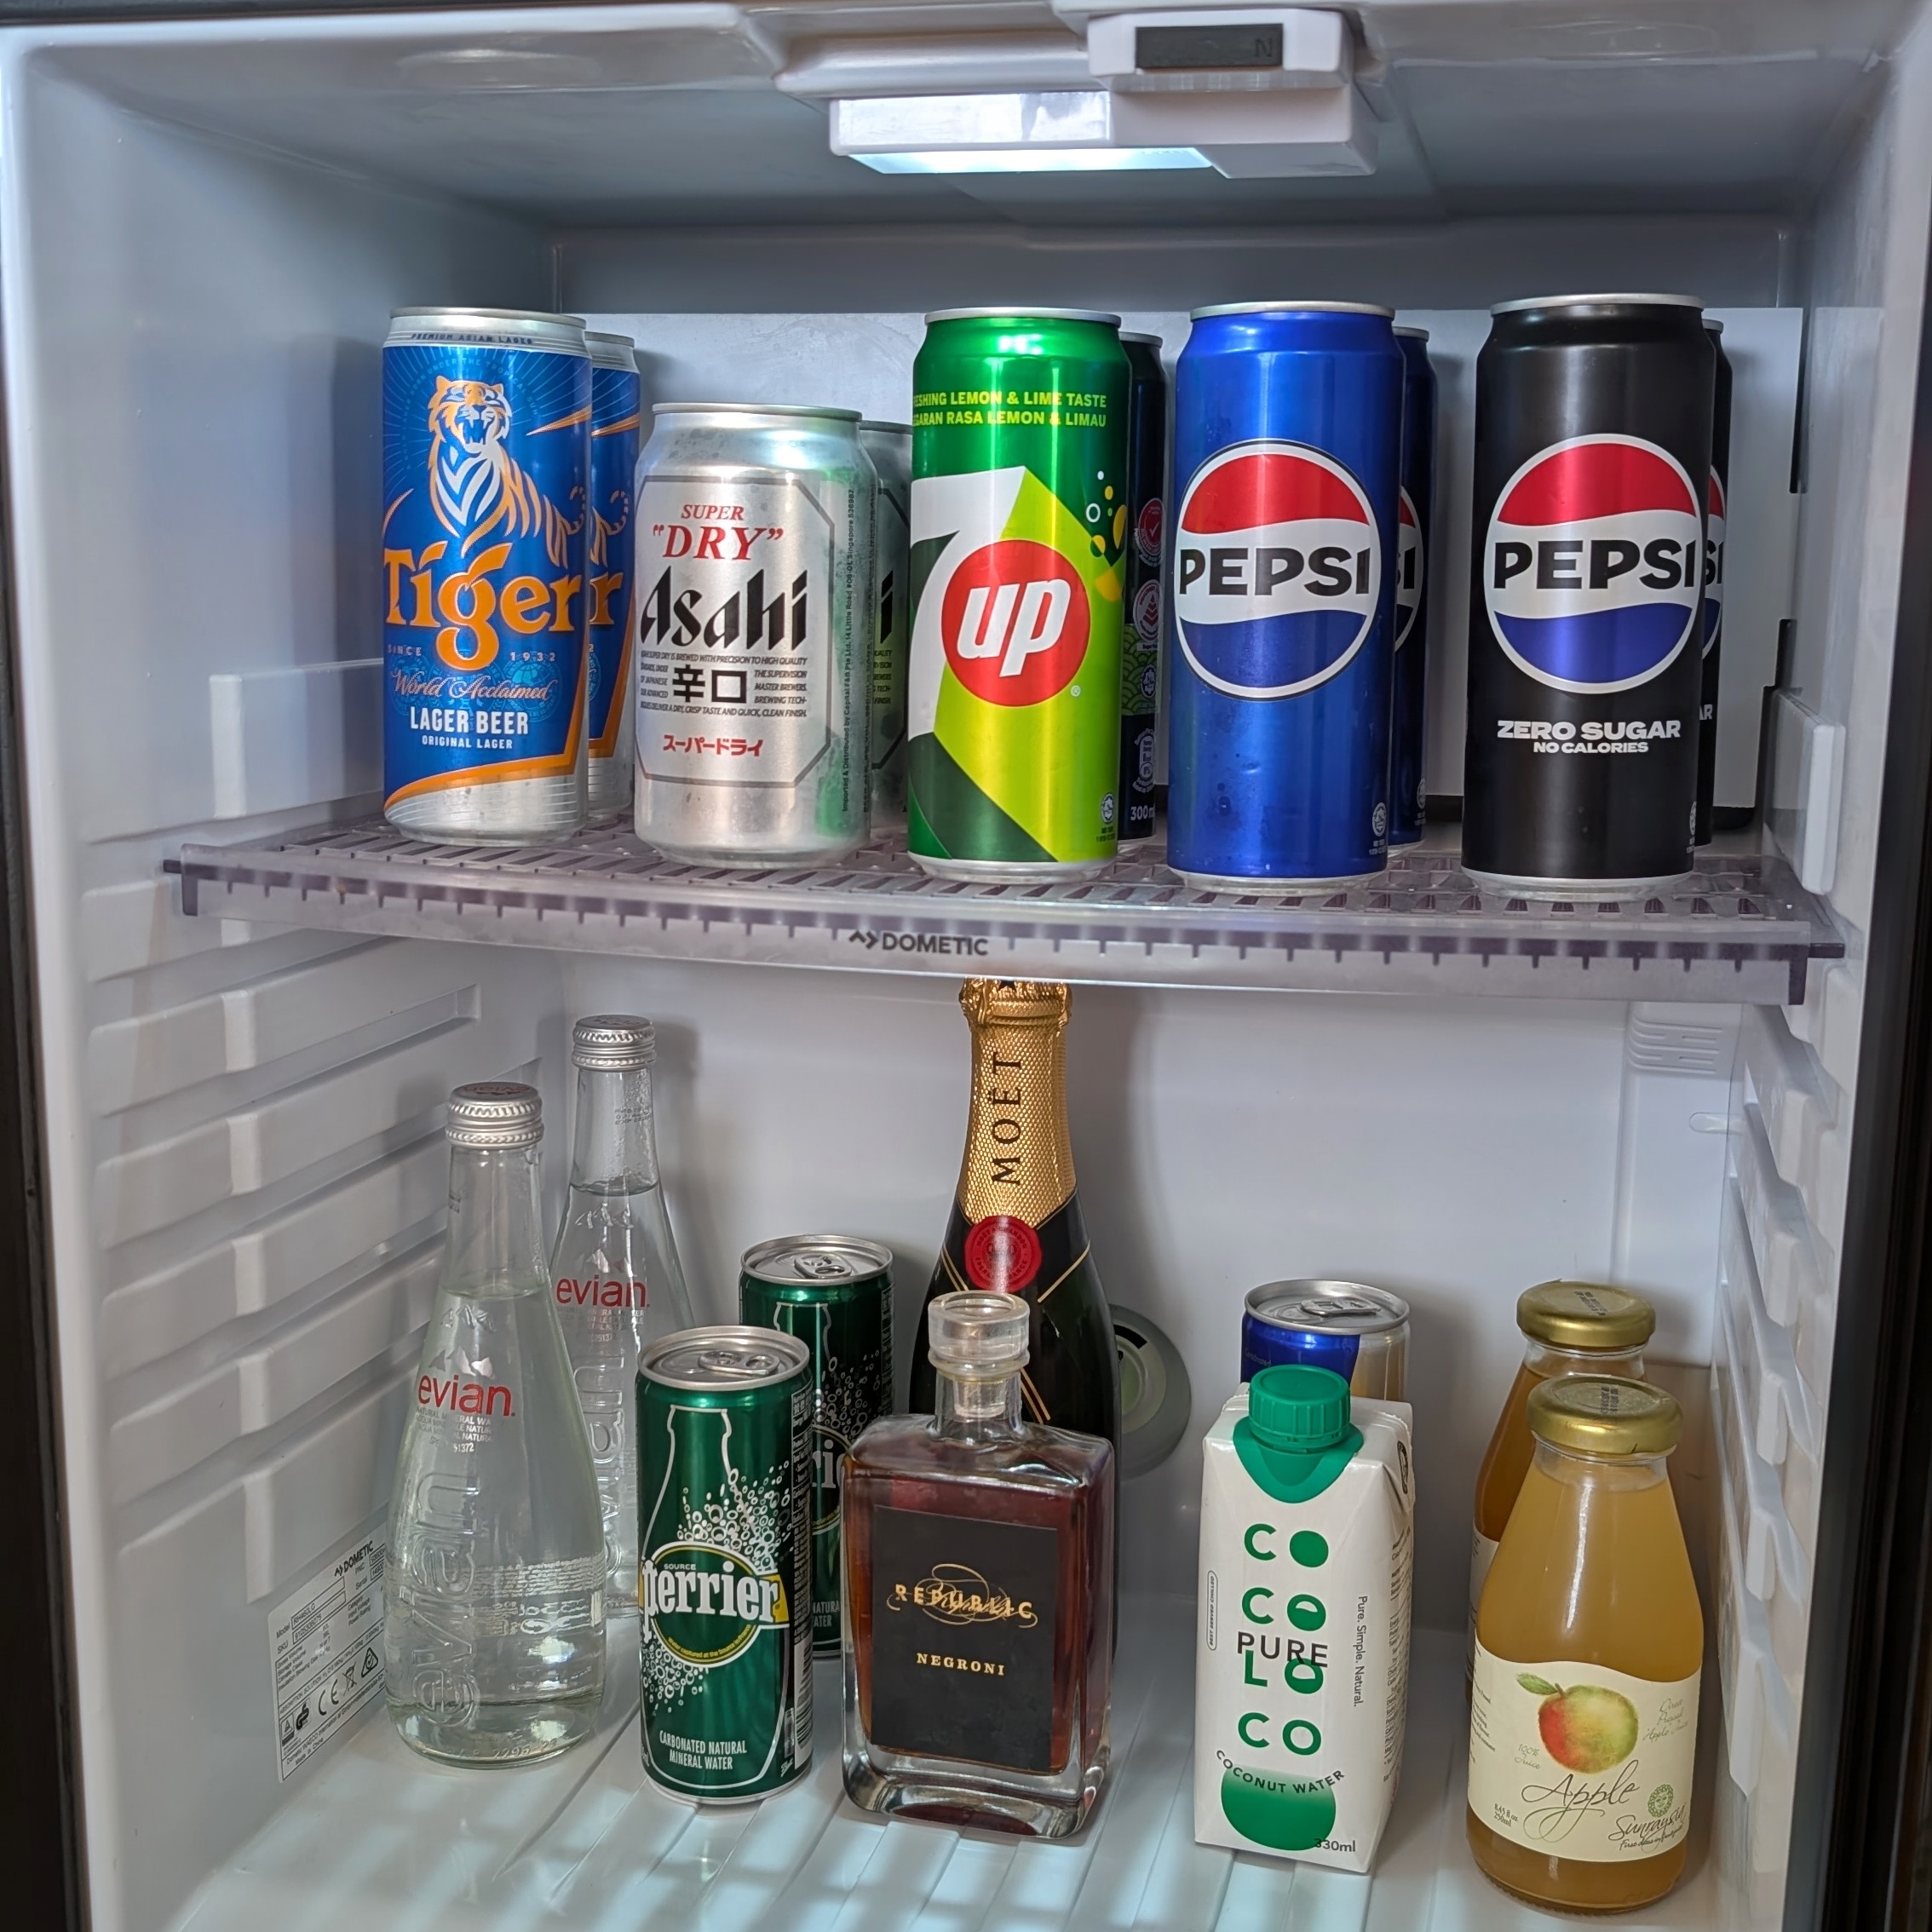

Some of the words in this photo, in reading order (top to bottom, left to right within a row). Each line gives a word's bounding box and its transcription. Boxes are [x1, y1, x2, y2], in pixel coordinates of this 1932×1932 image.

[458, 334, 492, 342] ASIAN
[462, 358, 481, 366] THE
[950, 391, 1002, 406] LEMON
[1006, 391, 1020, 405] &
[1024, 392, 1062, 405] LIME
[1066, 393, 1107, 409] TASTE
[946, 411, 983, 425] RASA
[987, 411, 1045, 425] LEMON
[1049, 411, 1061, 426] &
[1066, 412, 1107, 428] LIMAU
[681, 503, 745, 521] SUPER
[1179, 545, 1371, 596] PEPSI
[1493, 538, 1697, 590] PEPSI
[383, 540, 582, 671] Tiger
[641, 565, 808, 651] Asahi
[957, 578, 1072, 678] up
[388, 643, 422, 657] SINCE
[779, 657, 808, 665] QUALITY
[391, 670, 449, 698] World
[672, 664, 748, 704] 辛口
[410, 706, 469, 731] LAGER
[476, 710, 529, 735] BEER
[703, 706, 722, 715] TASTE
[722, 707, 737, 716] AND
[422, 734, 472, 748] ORIGINAL
[476, 737, 513, 749] LAGER
[1498, 720, 1577, 740] ZERO
[1580, 719, 1682, 741] SUGAR
[663, 733, 763, 757] スーパードライ
[1533, 741, 1557, 753] NO
[1565, 741, 1649, 754] CALORIES
[883, 932, 988, 956] DOMETIC
[343, 1540, 372, 1573] DOMETIC
[664, 1562, 697, 1572] SOURCE
[641, 1560, 779, 1644] perrier
[1358, 1595, 1368, 1622] Pure.
[1237, 1630, 1329, 1668] PURE
[1355, 1622, 1367, 1665] Simple.
[916, 1652, 1005, 1676] NEGRONI
[1353, 1665, 1365, 1707] Natural.
[659, 1729, 706, 1754] CARBONATED
[708, 1739, 748, 1756] NATURAL
[1518, 1743, 1540, 1757] 100%
[669, 1749, 703, 1769] MINERAL
[704, 1756, 733, 1770] WATER
[1514, 1752, 1542, 1769] Juice
[1216, 1749, 1286, 1793] COCONUT
[1292, 1769, 1345, 1795] WATER
[1521, 1759, 1641, 1843] Apple
[1493, 1811, 1512, 1827] 250ml
[1314, 1837, 1356, 1853] 330ml
